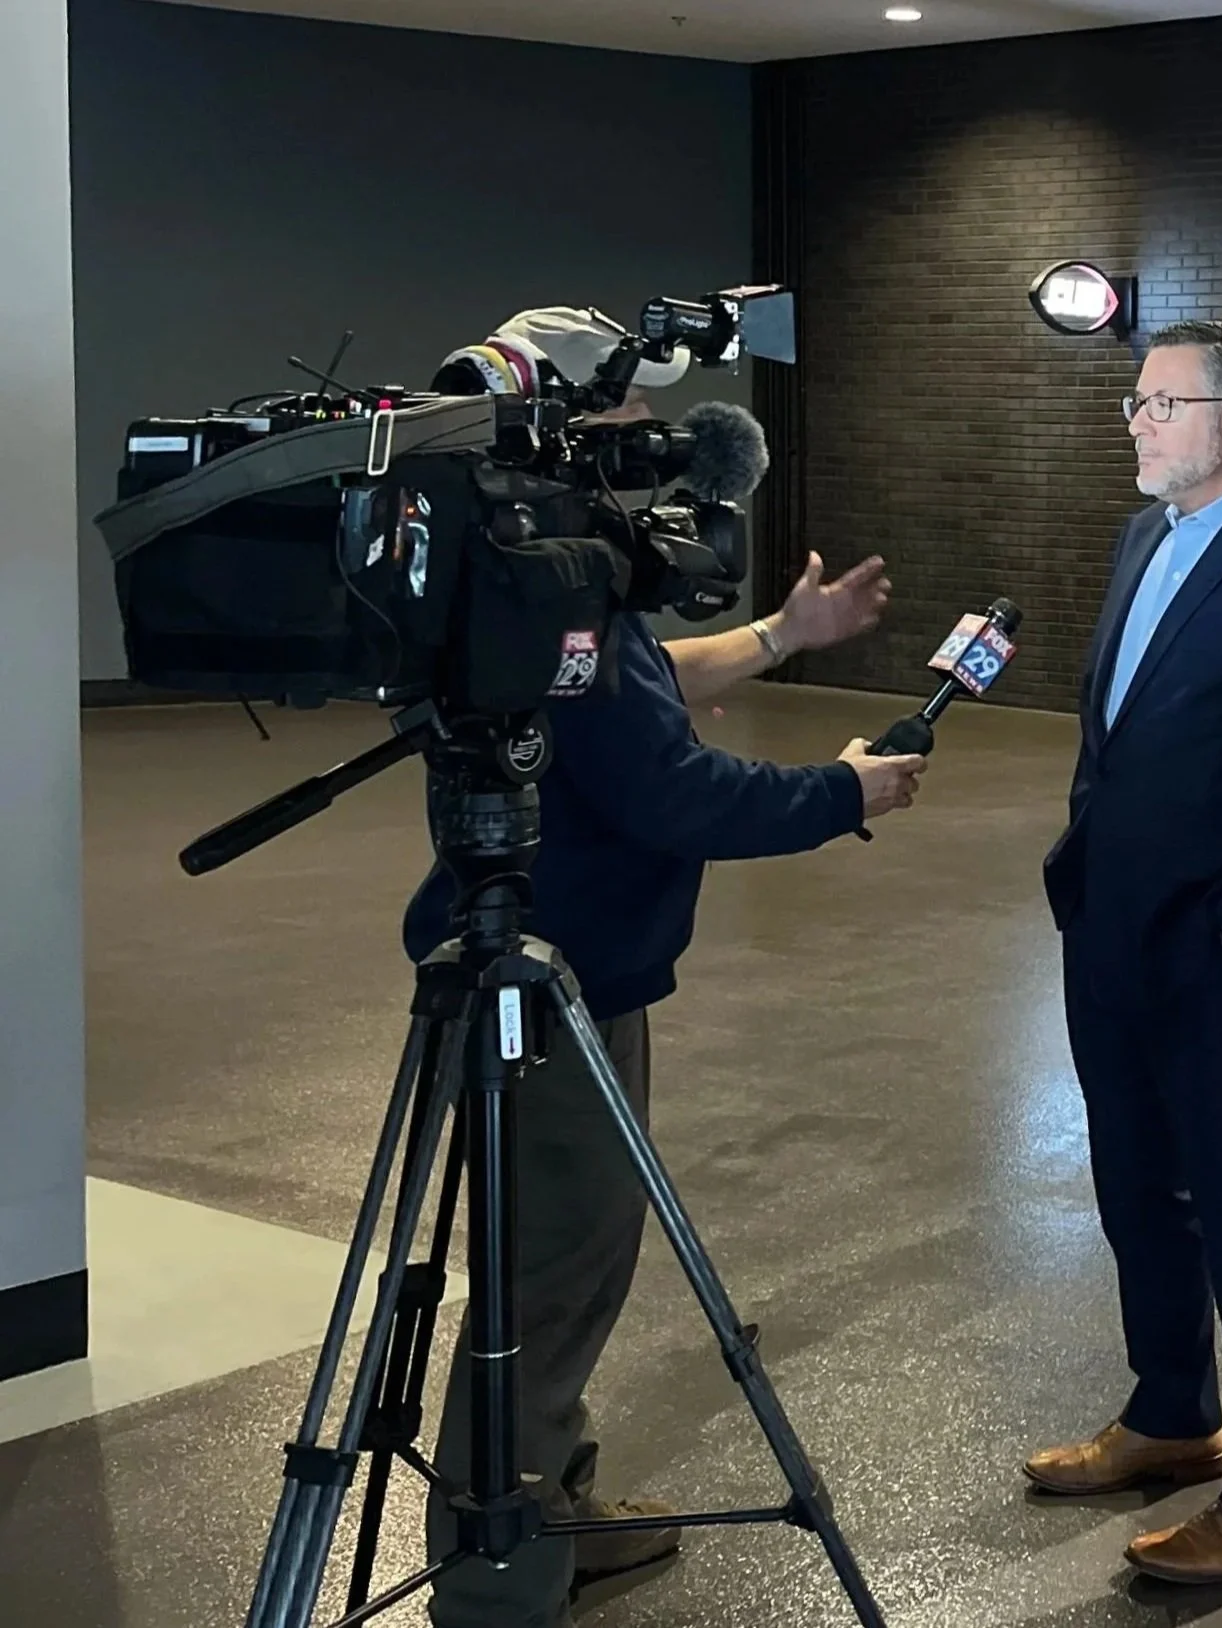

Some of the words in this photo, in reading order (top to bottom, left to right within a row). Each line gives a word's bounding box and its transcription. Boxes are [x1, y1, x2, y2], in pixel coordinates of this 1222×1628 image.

[565, 632, 595, 651] FOX
[940, 635, 972, 657] 29
[984, 627, 1014, 657] FOX
[556, 658, 595, 686] 29
[961, 645, 1000, 679] 29
[504, 1003, 516, 1034] Lock
